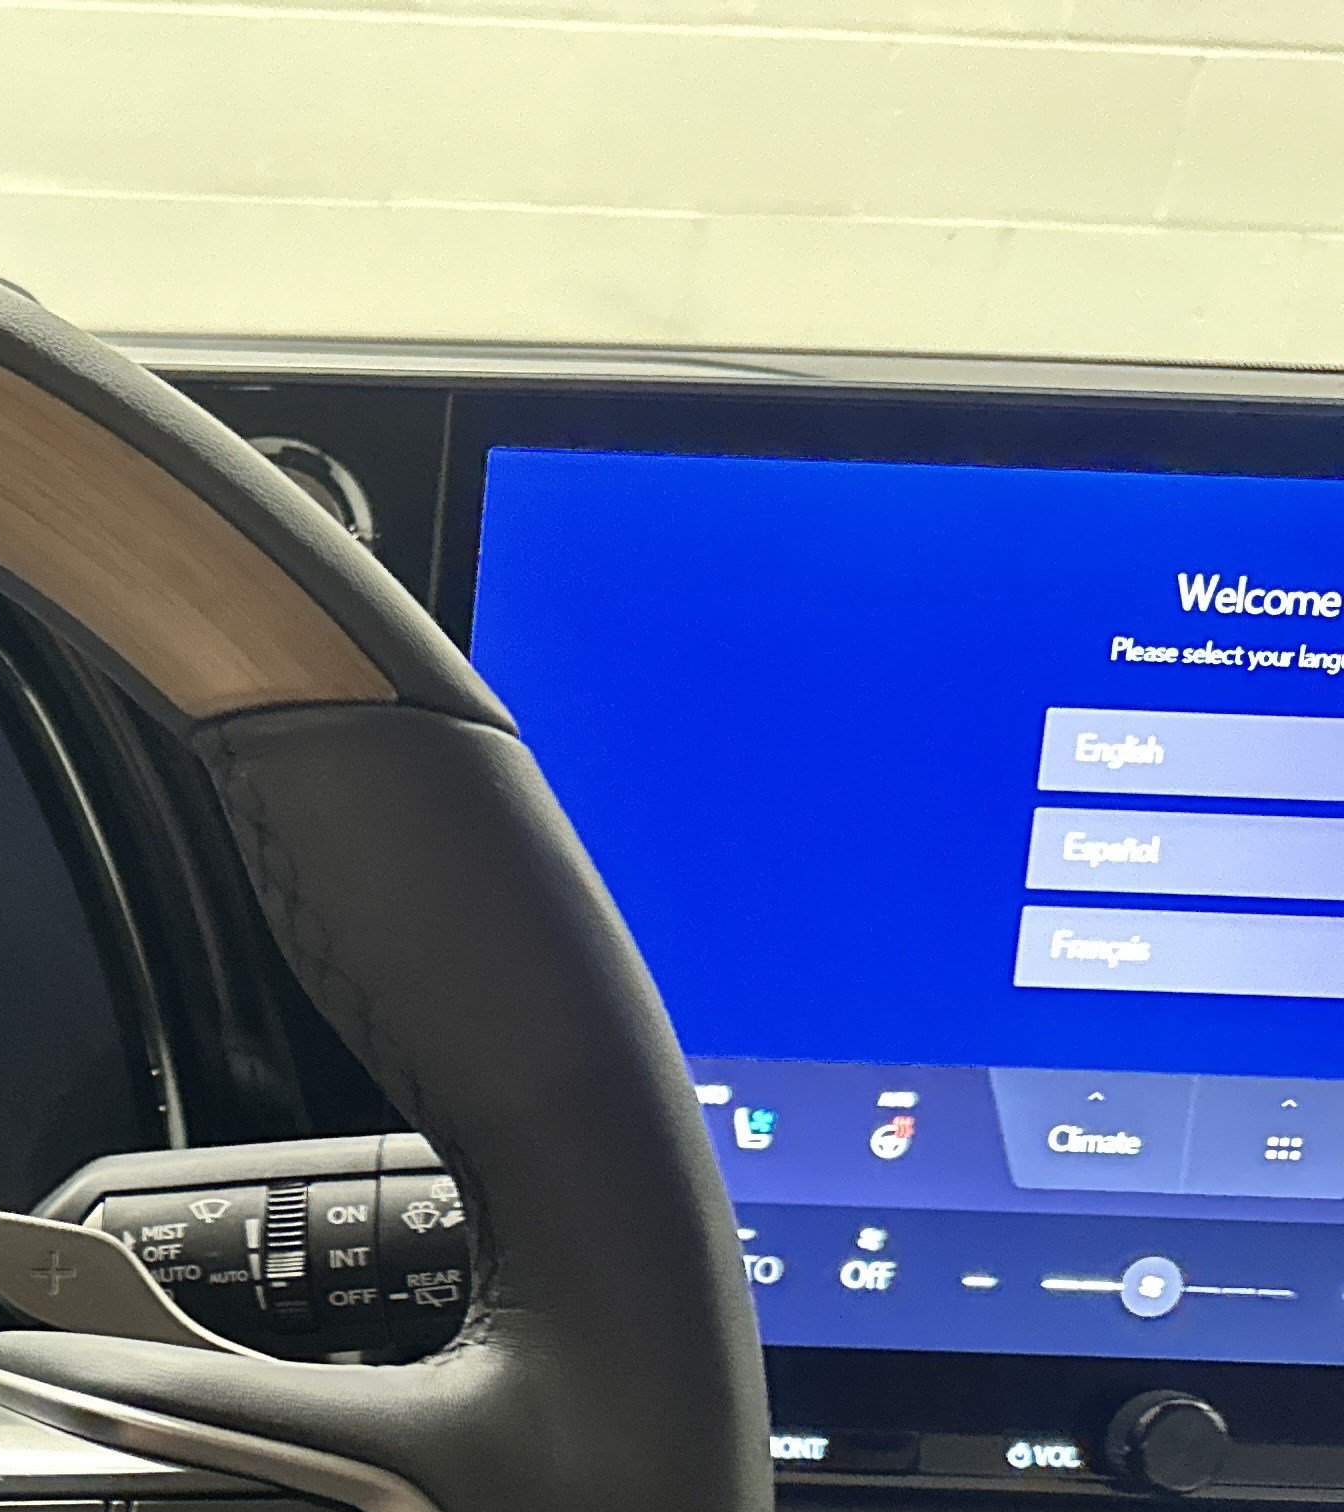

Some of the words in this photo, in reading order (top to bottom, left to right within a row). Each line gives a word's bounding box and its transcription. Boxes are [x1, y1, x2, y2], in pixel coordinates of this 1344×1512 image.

[1178, 572, 1342, 618] Welcome
[1111, 636, 1179, 663] Please
[1182, 640, 1245, 666] select
[1247, 649, 1295, 671] your
[1075, 732, 1165, 769] English
[1063, 832, 1161, 868] Español
[1050, 929, 1150, 968] Français
[1048, 1123, 1143, 1155] Climate
[327, 1205, 368, 1225] ON
[141, 1223, 188, 1242] MIST
[142, 1243, 183, 1262] OFF
[329, 1247, 369, 1269] INT
[209, 1270, 249, 1284] AUTO
[407, 1269, 461, 1287] REAR
[329, 1288, 378, 1307] OFF
[1033, 1445, 1081, 1468] VOL
